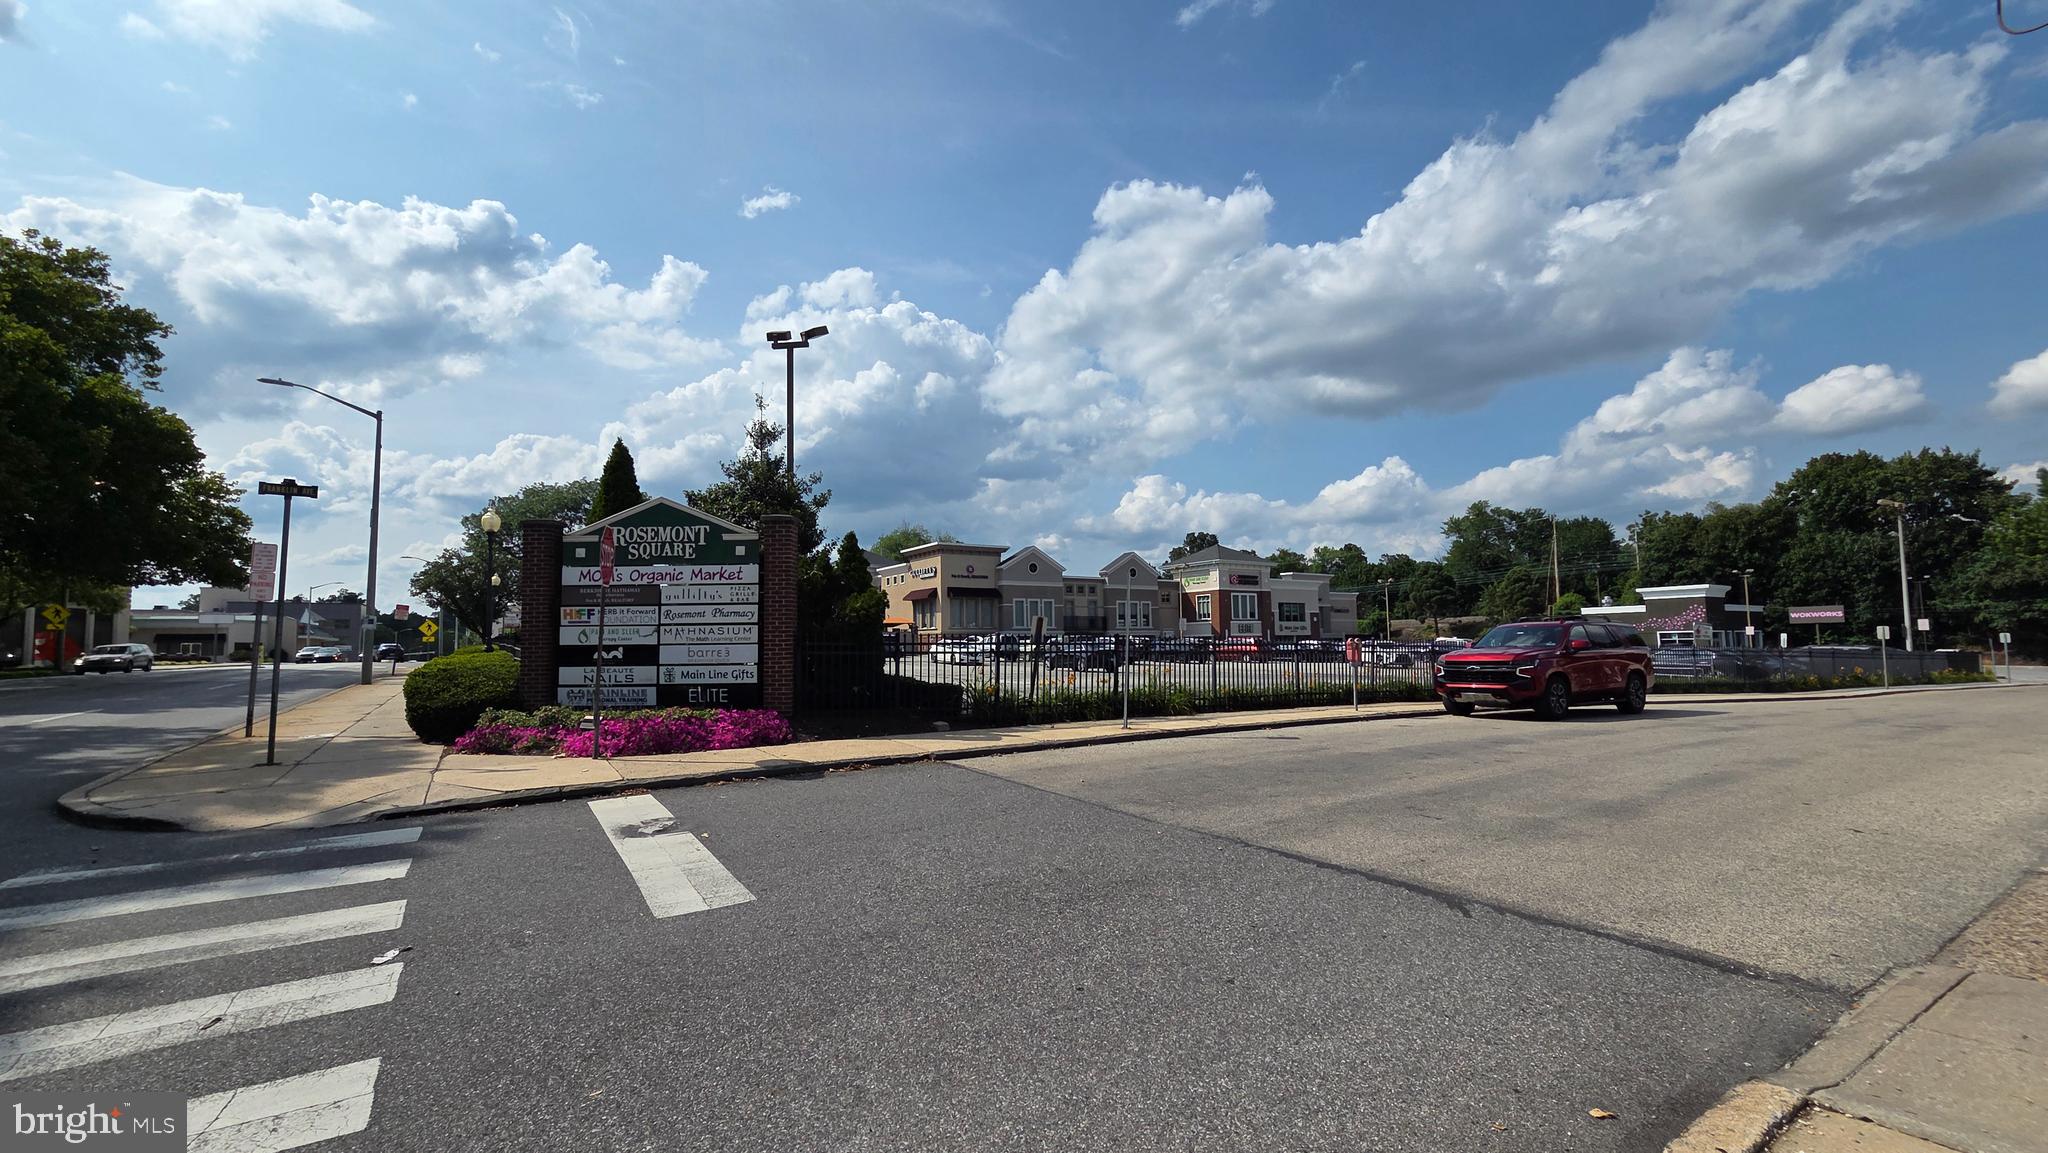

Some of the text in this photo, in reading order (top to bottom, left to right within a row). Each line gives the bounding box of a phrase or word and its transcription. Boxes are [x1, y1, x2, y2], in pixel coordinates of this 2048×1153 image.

[613, 525, 710, 546] ROSEMONT
[628, 542, 696, 560] SQUARE
[578, 566, 744, 584] MO's Organic Market
[626, 607, 656, 615] Forward
[663, 607, 755, 622] Rosemont Pharmacy
[583, 674, 634, 683] NAILS
[681, 669, 754, 681] Main Line Gifts
[688, 685, 729, 703] ELITE
